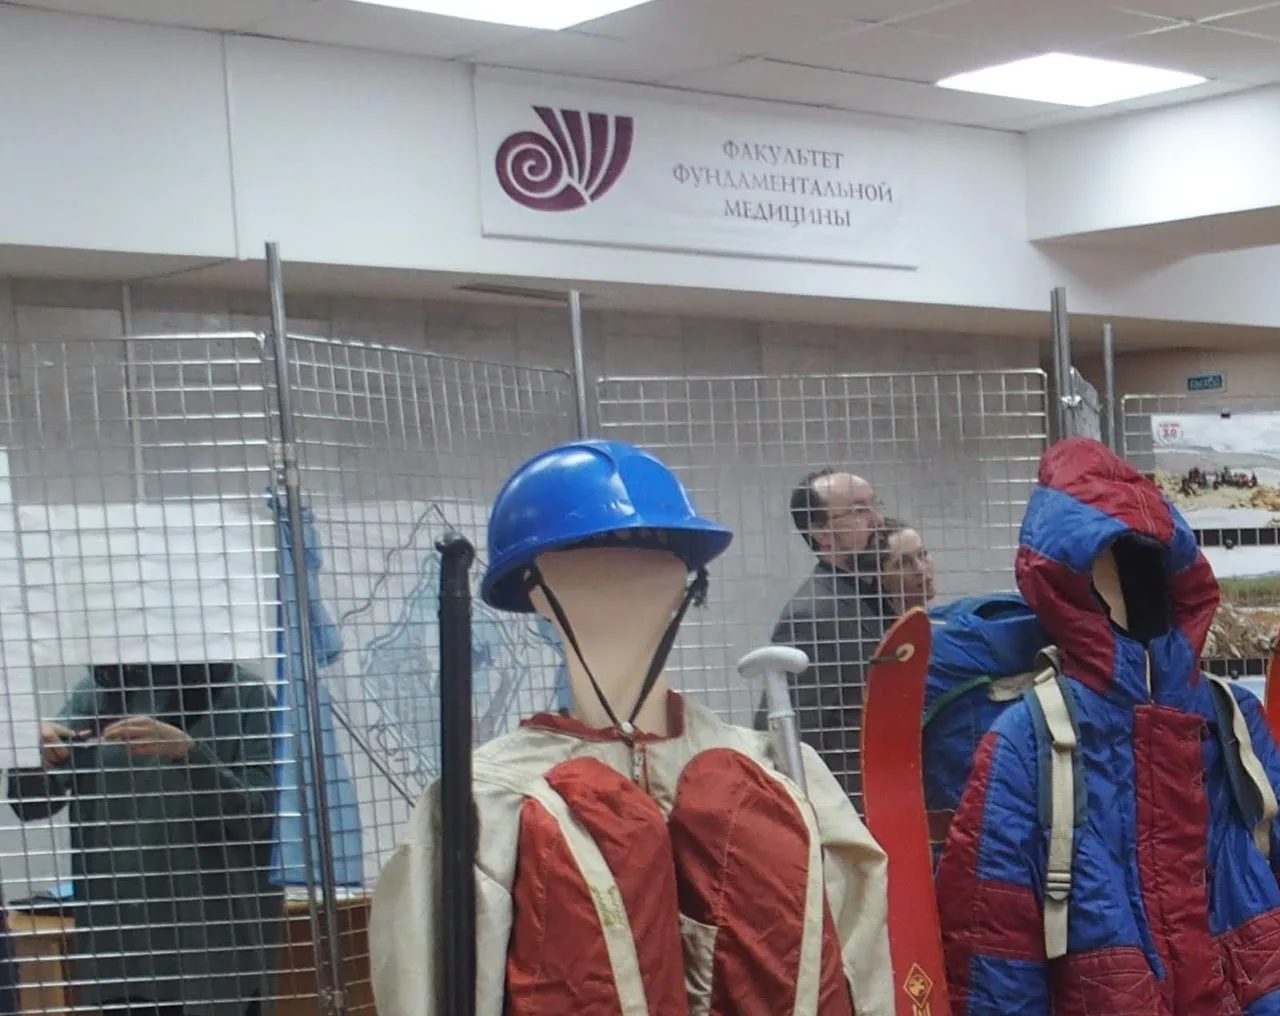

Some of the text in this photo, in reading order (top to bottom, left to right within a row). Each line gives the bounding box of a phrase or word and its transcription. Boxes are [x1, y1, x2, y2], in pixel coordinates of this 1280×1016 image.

[722, 139, 844, 170] ФАКУЛЬТЕТ
[672, 162, 894, 204] ФУНДАМЕНТАЛЬНОЙ
[723, 199, 852, 229] МЕДИЦИНЫ
